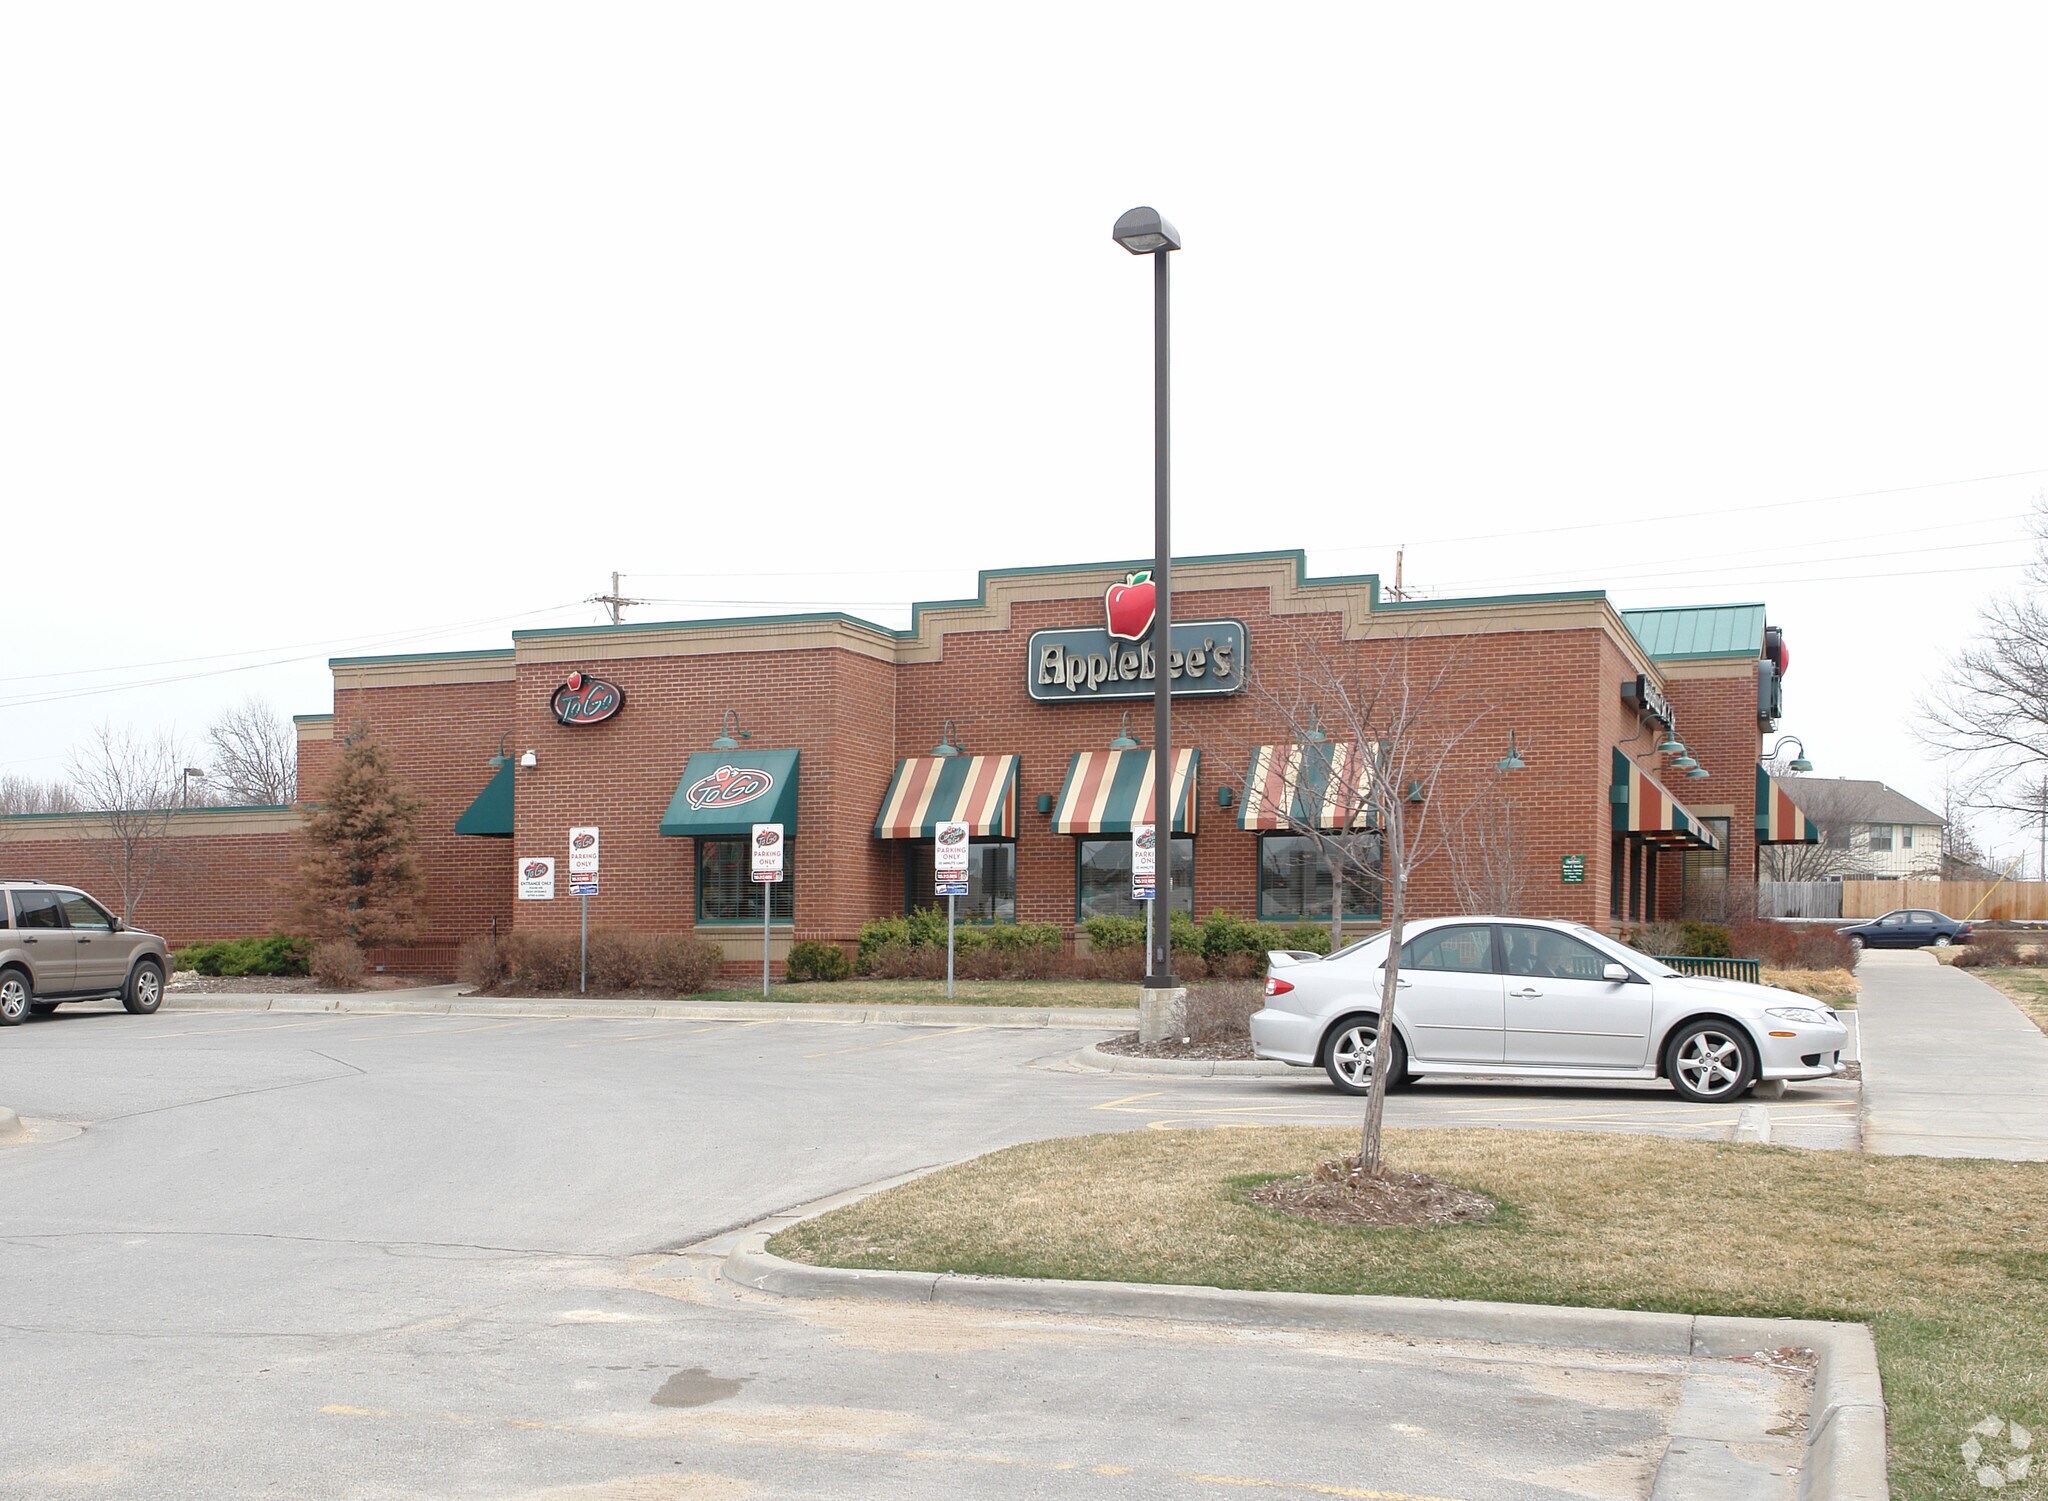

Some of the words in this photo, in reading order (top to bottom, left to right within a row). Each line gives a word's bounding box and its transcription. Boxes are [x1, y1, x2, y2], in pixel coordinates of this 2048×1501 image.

[561, 695, 581, 722] To
[583, 685, 613, 717] Go
[695, 784, 721, 808] To
[721, 775, 759, 800] Go
